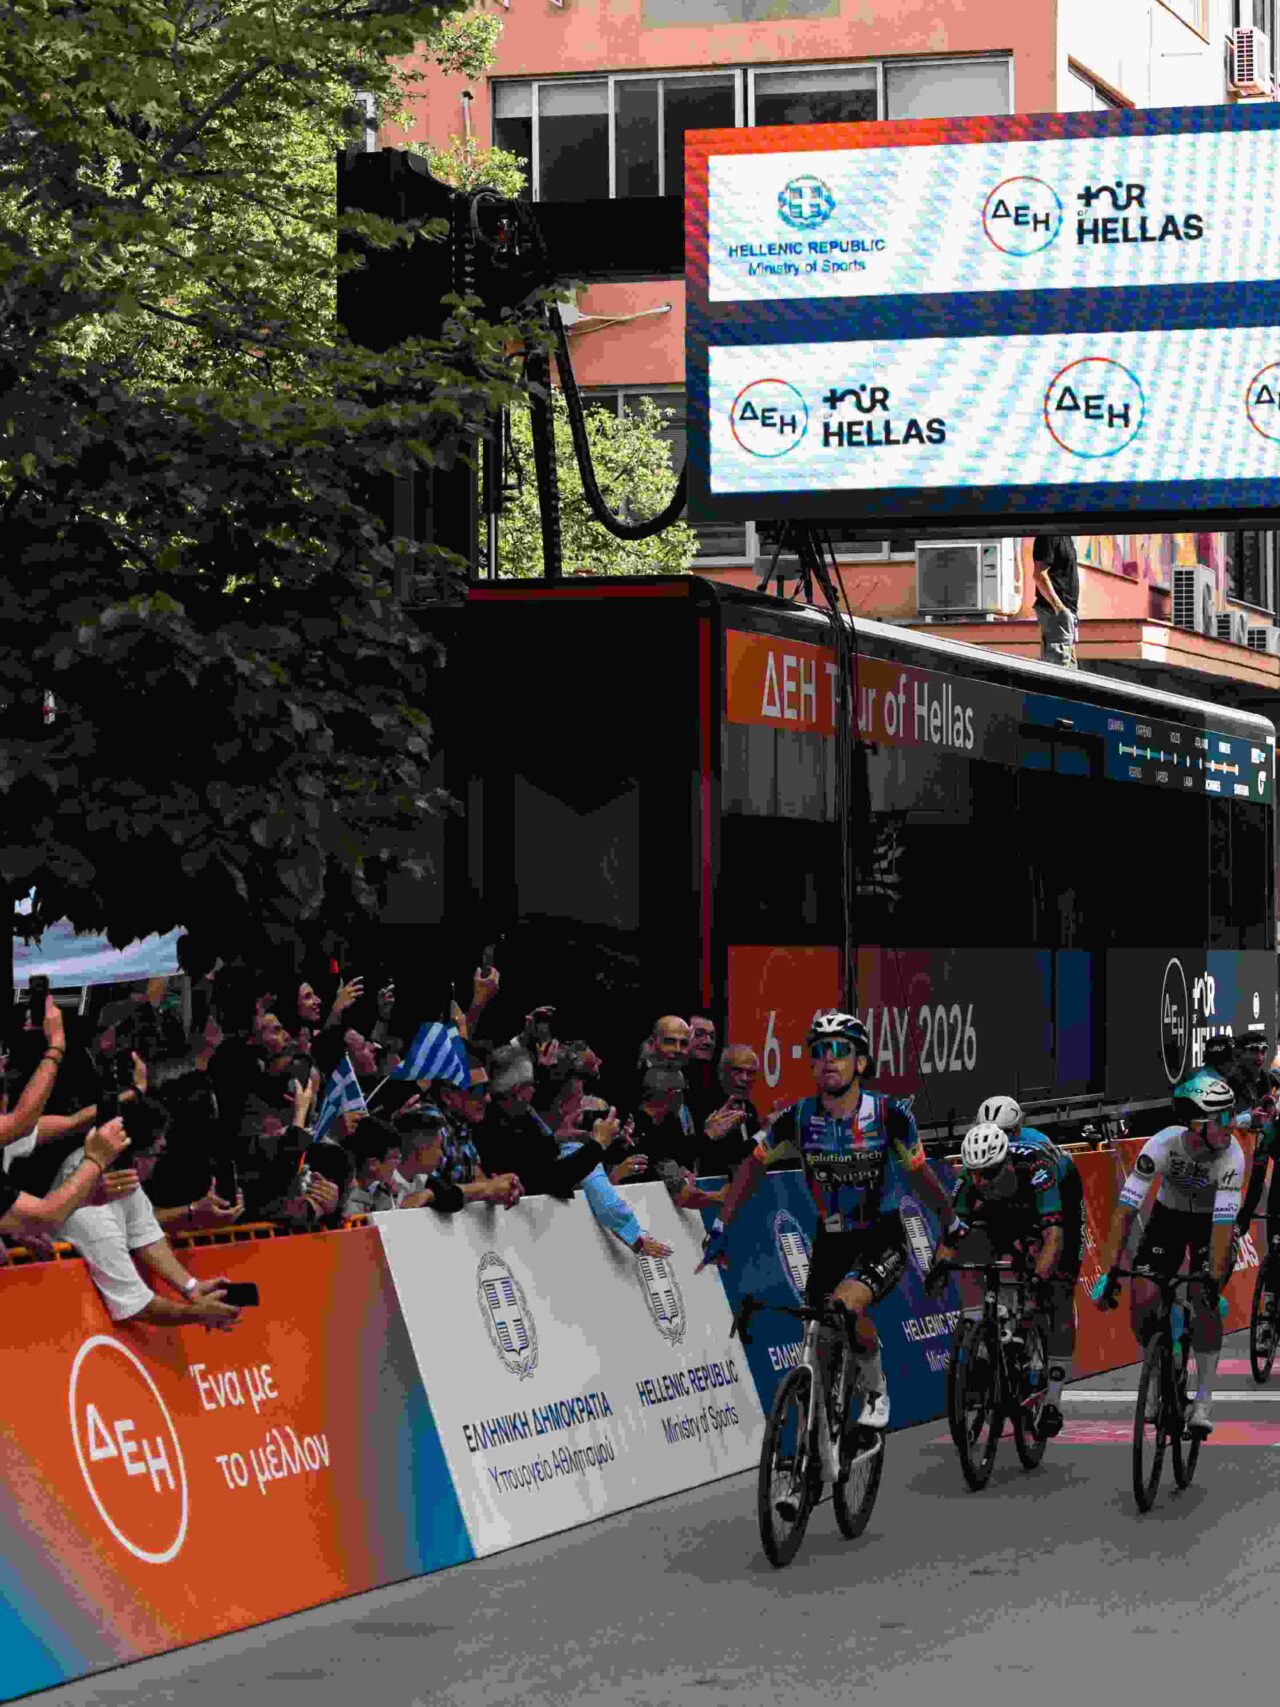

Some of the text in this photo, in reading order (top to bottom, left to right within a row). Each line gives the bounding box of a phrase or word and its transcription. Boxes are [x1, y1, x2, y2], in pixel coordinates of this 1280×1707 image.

[728, 239, 886, 258] HELLENIC REPUBLIC
[1077, 214, 1204, 245] HELLAS
[748, 259, 866, 276] Ministry of Sports
[822, 418, 946, 447] HELLAS
[761, 650, 975, 750] ΔΕΗ Tur of Hellas
[763, 1010, 781, 1088] 6
[918, 1003, 977, 1074] 2026
[854, 1150, 884, 1162] Tech
[901, 1313, 949, 1341] HELLENIC
[768, 1342, 804, 1371] ΕΛΛΗΝ
[189, 1363, 278, 1414] Ένα με
[636, 1359, 738, 1407] HELLENIC REPUBLIC
[462, 1391, 613, 1453] ΕΛΛΗΝΙΚΗ ΔΗΜΟΚΡΑΤΙΑ
[661, 1402, 739, 1444] Ministry of Sports
[86, 1403, 176, 1492] ΔΕΗ
[216, 1425, 330, 1495] το μέλλον
[551, 1435, 615, 1477] Αθλητισμού
